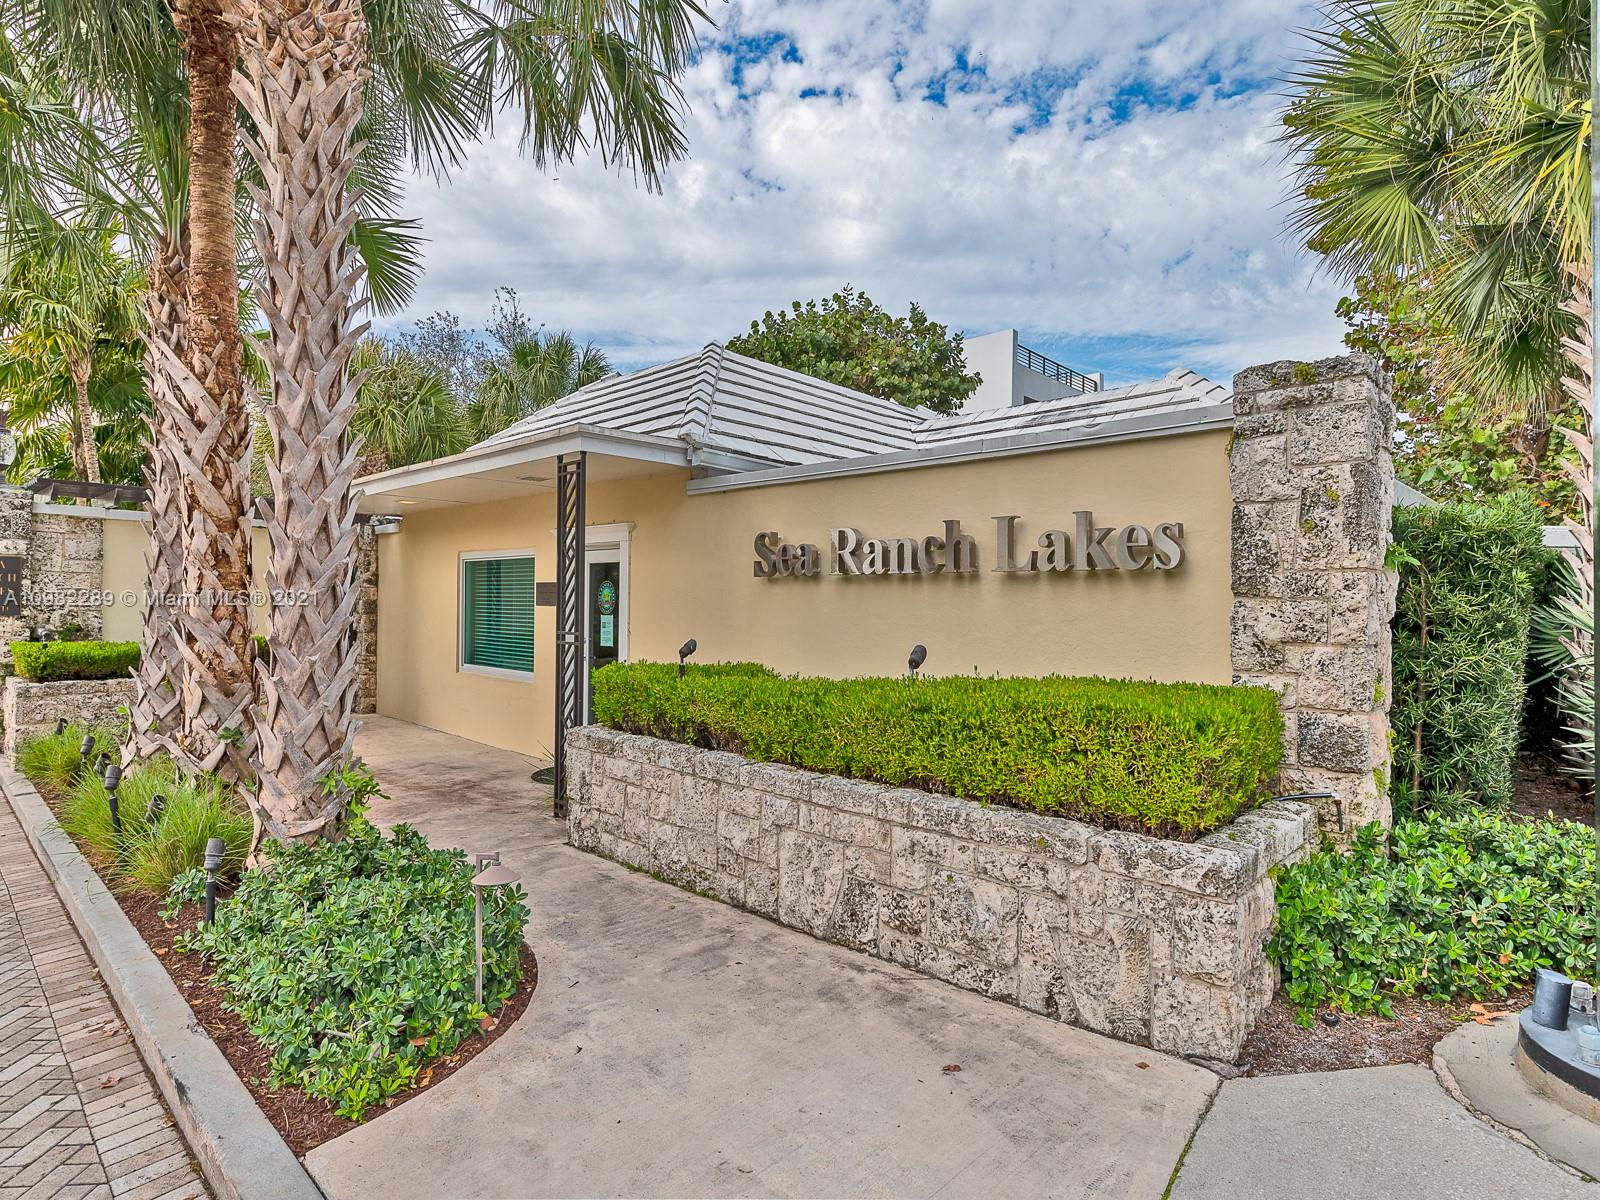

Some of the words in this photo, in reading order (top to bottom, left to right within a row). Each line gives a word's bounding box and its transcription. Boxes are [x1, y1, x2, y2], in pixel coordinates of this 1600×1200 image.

[753, 531, 821, 578] Sea
[828, 519, 980, 576] Ranch
[990, 510, 1186, 573] Lakes
